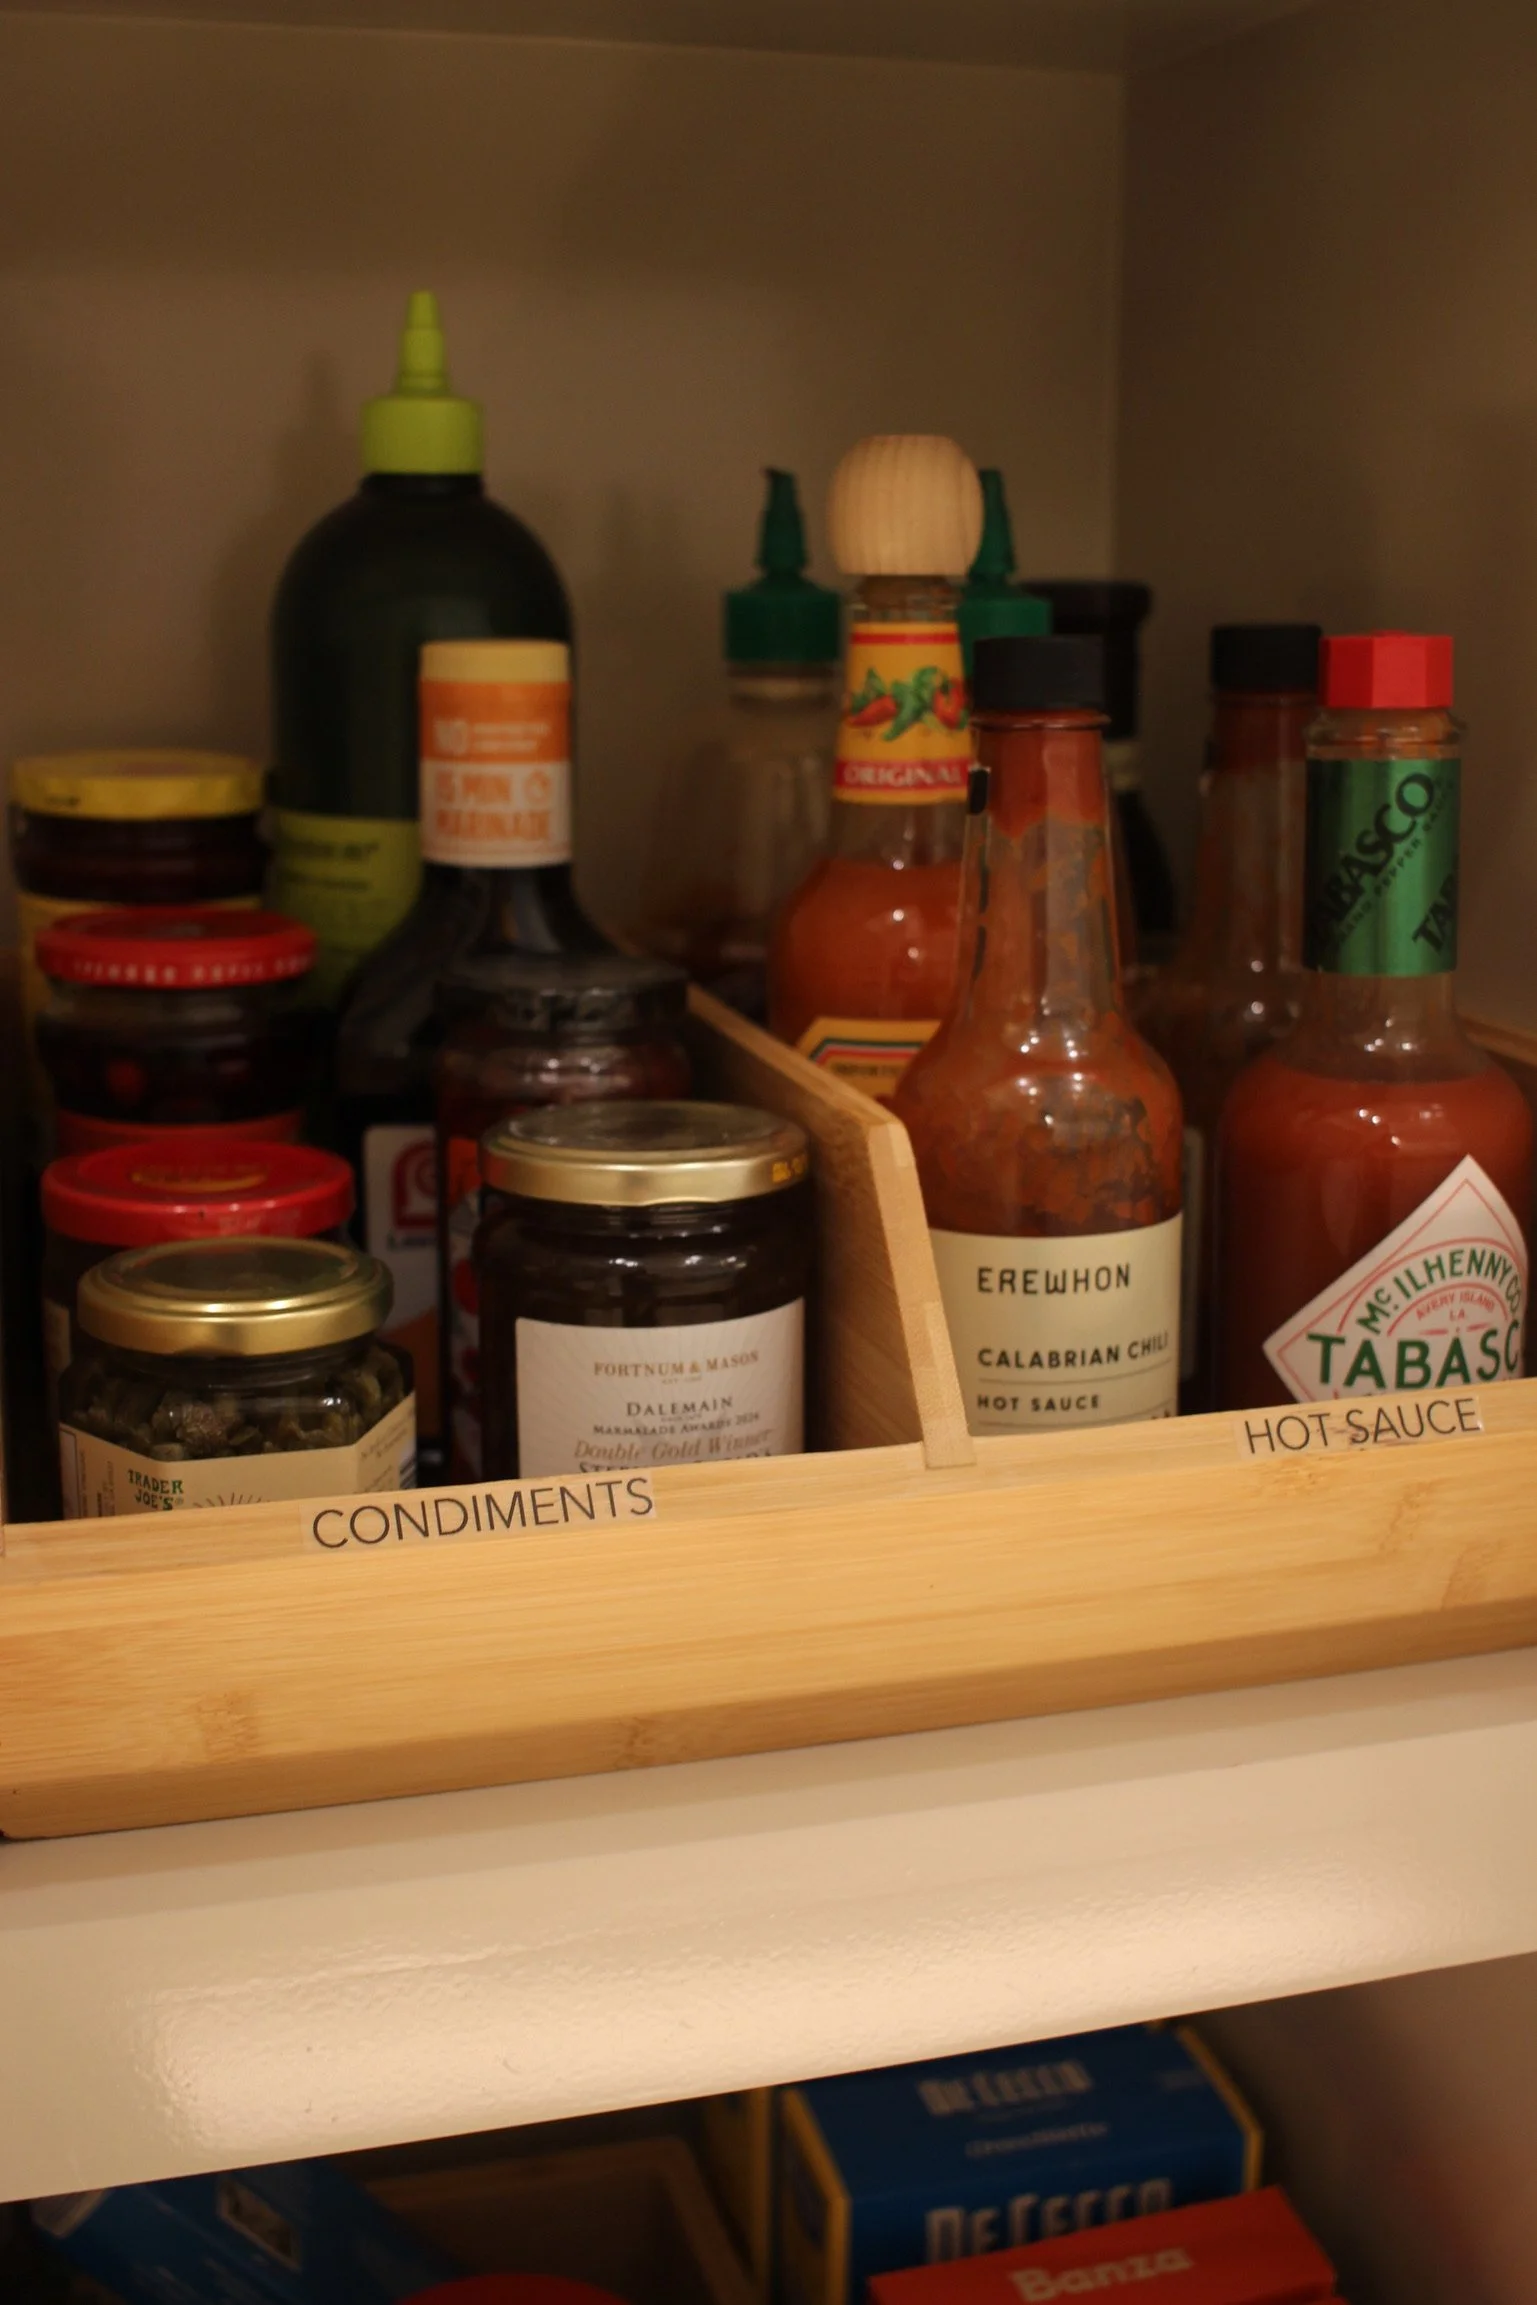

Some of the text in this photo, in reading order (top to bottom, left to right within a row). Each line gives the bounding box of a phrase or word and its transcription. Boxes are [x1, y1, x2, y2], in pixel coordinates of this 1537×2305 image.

[843, 764, 964, 788] ORIGINAL
[1311, 772, 1435, 950] ABASCO
[976, 1263, 1131, 1295] EREWHON
[593, 1350, 759, 1378] FORTNUM & MASON
[977, 1345, 1121, 1369] CALABRIAN
[1306, 1318, 1520, 1390] TABASC
[626, 1397, 733, 1417] DALEMAIN
[976, 1394, 1100, 1412] HOT SAUCE
[1244, 1397, 1481, 1454] HOT SAUCE
[574, 1438, 640, 1461] Double
[651, 1437, 701, 1460] Gold
[708, 1429, 773, 1454] Winner
[128, 1469, 184, 1494] TRADER
[312, 1476, 654, 1549] CONDIMENTS
[1009, 2247, 1194, 2304] Banza
